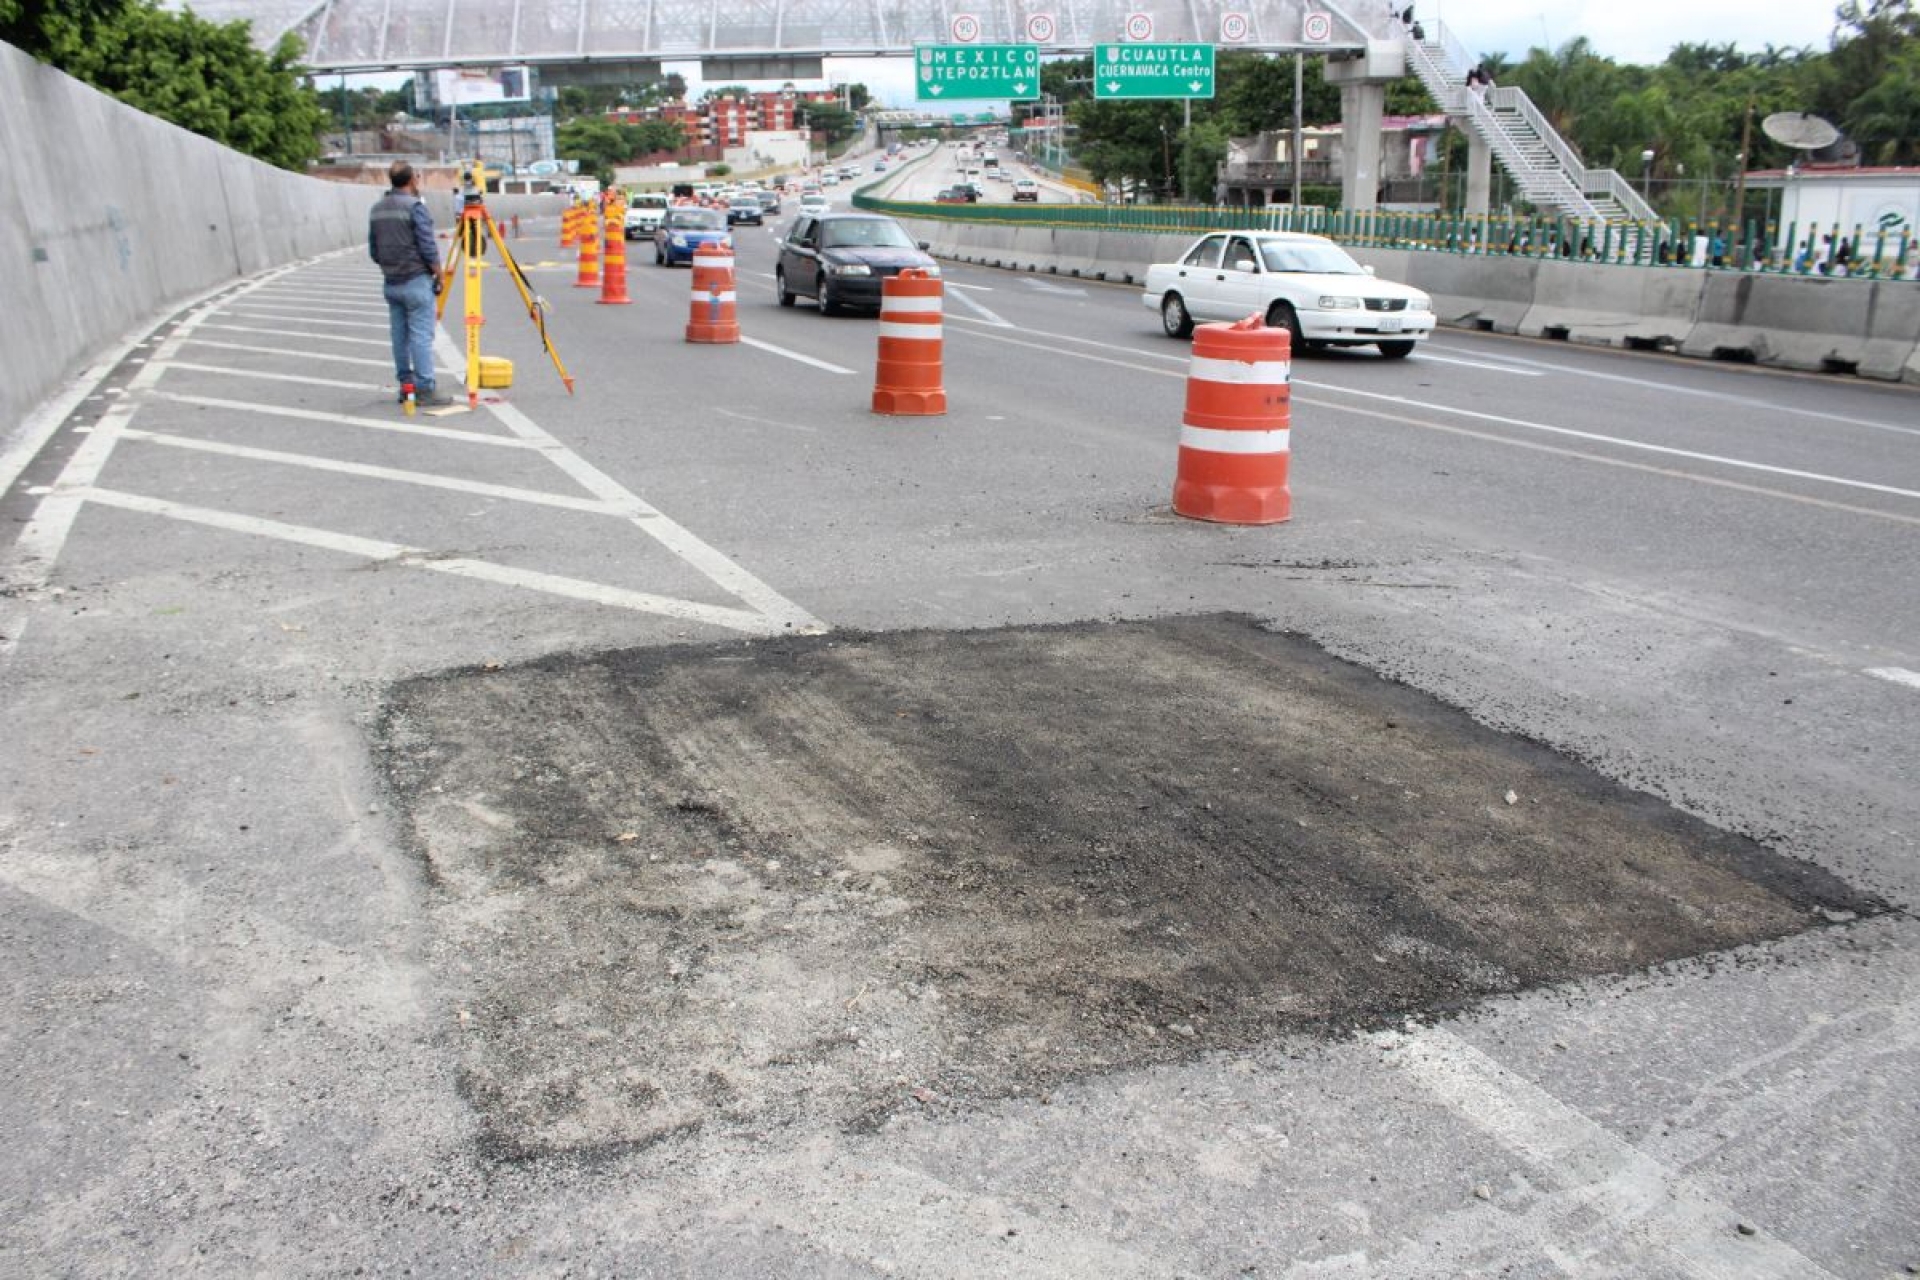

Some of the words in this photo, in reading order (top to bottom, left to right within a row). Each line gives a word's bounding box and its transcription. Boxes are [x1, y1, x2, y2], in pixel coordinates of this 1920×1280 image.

[959, 21, 971, 32] 90
[1035, 21, 1047, 32] 90
[1133, 20, 1145, 31] 60
[1228, 20, 1240, 31] 60
[935, 50, 1035, 63] MEXICO
[1121, 49, 1202, 61] CUAUTLA
[935, 66, 1035, 79] TEPOZTLAN
[1098, 64, 1168, 77] CUERNAVACA
[1173, 64, 1210, 76] Centro
